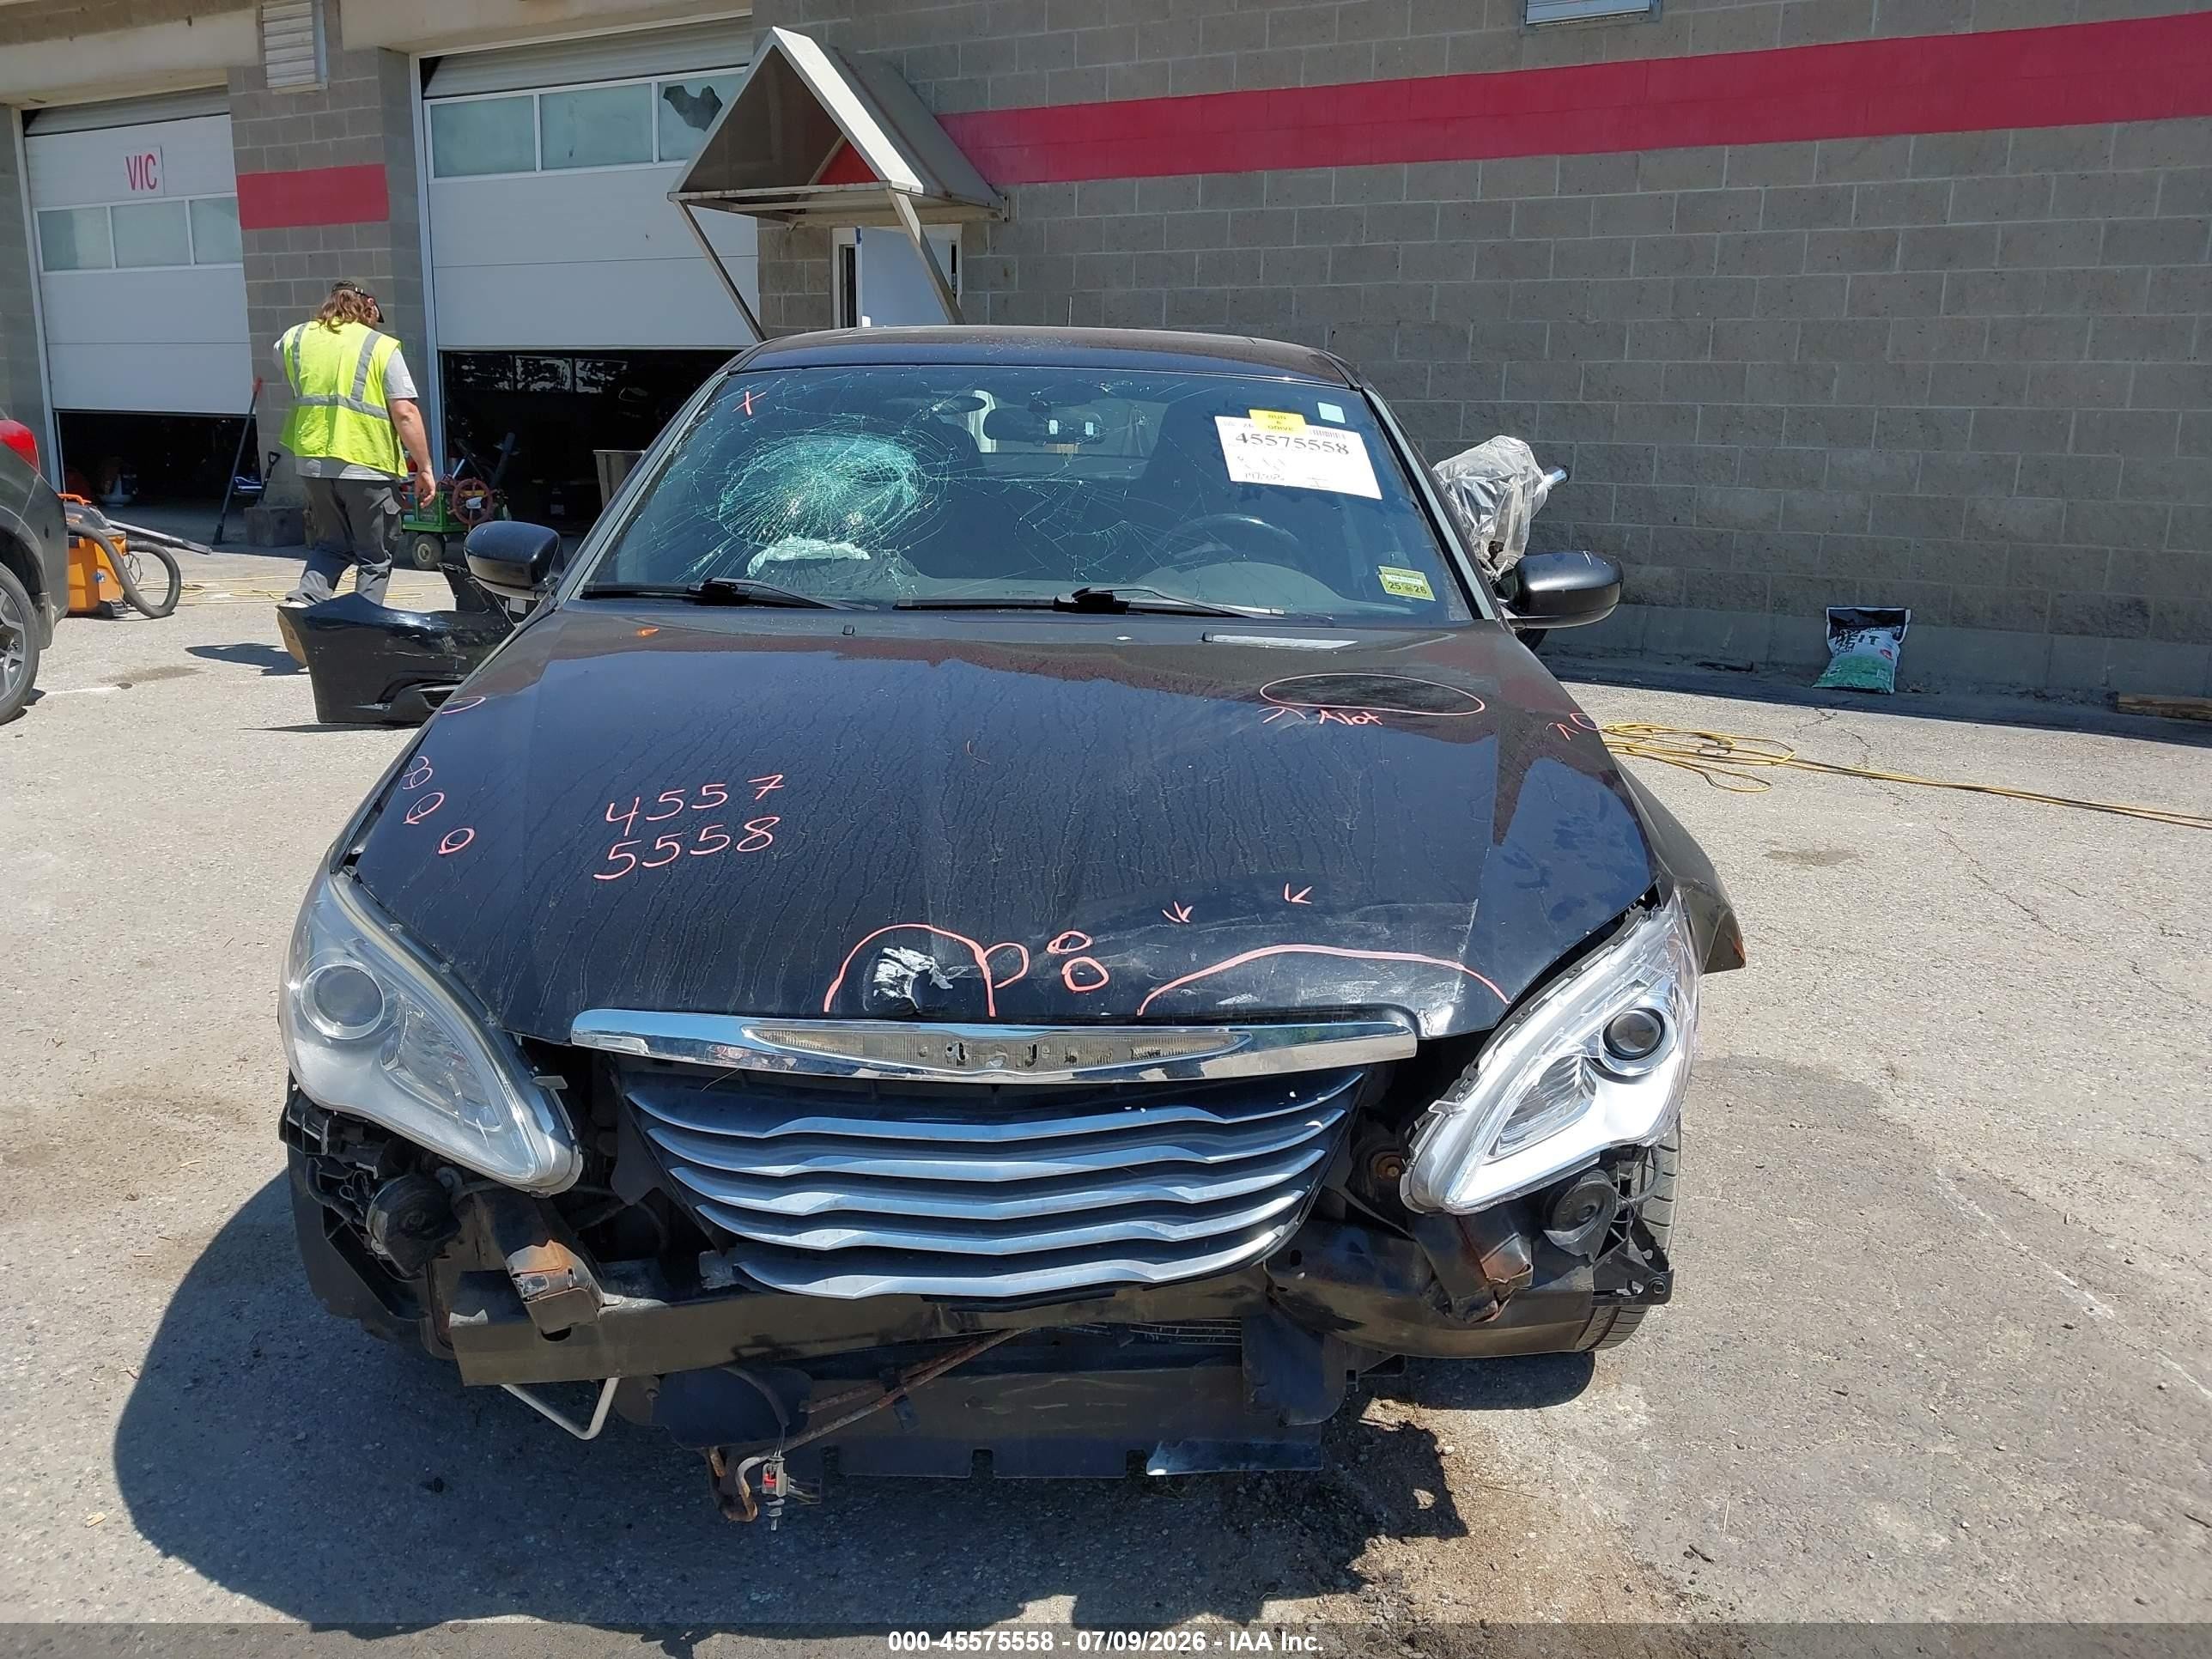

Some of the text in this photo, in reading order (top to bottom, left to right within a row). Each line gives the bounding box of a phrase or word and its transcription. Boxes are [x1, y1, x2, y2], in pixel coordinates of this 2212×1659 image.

[125, 154, 157, 191] VIC
[1236, 432, 1350, 456] 45575558
[1388, 581, 1401, 590] 25
[605, 774, 785, 837] 4557
[592, 816, 781, 881] 5558
